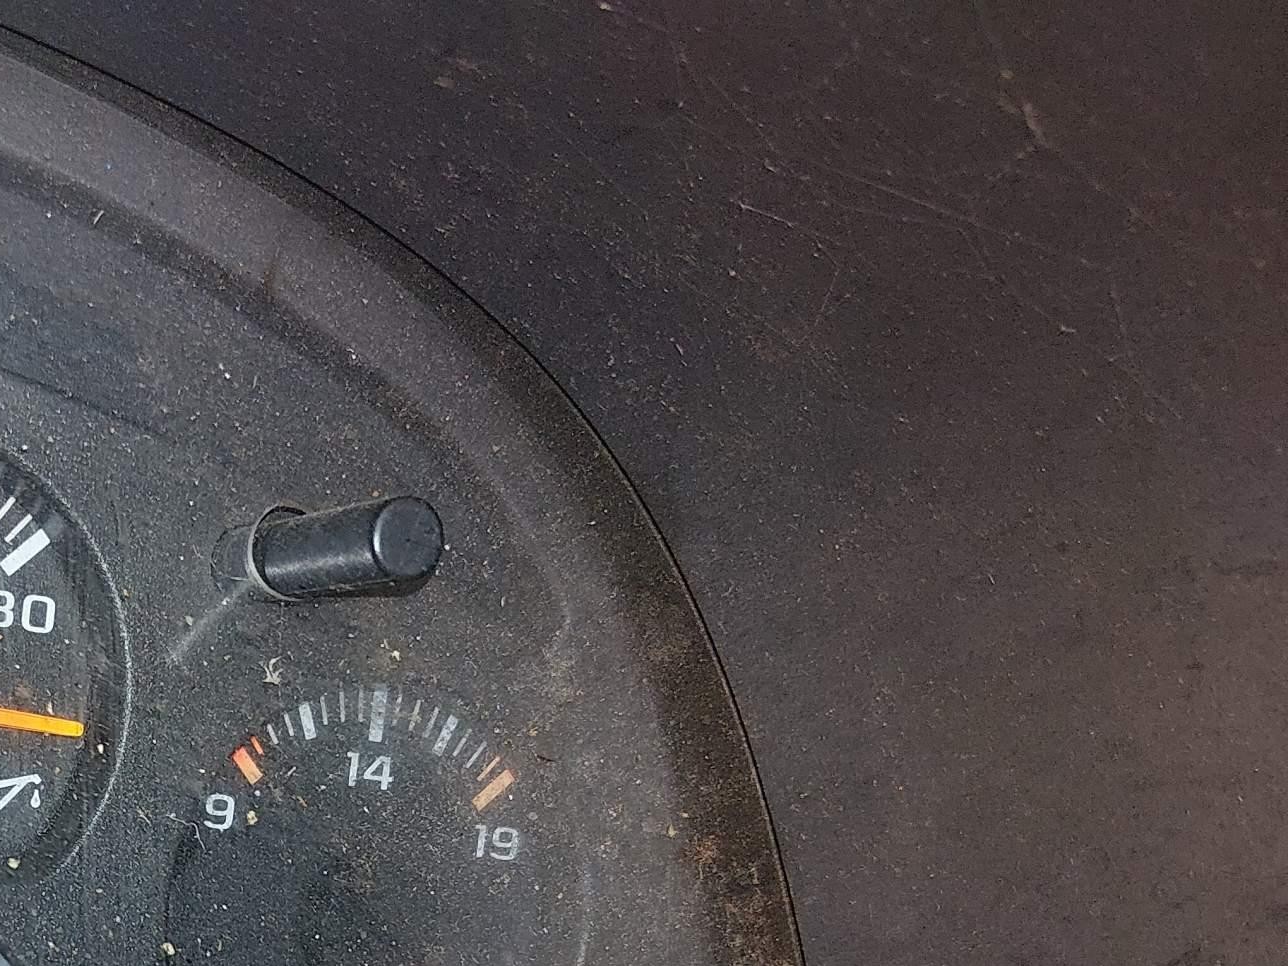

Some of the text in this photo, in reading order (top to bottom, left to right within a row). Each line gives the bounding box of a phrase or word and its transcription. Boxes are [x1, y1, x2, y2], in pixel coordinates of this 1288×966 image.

[346, 751, 394, 791] 14
[204, 793, 235, 831] 9
[475, 824, 520, 861] 19
